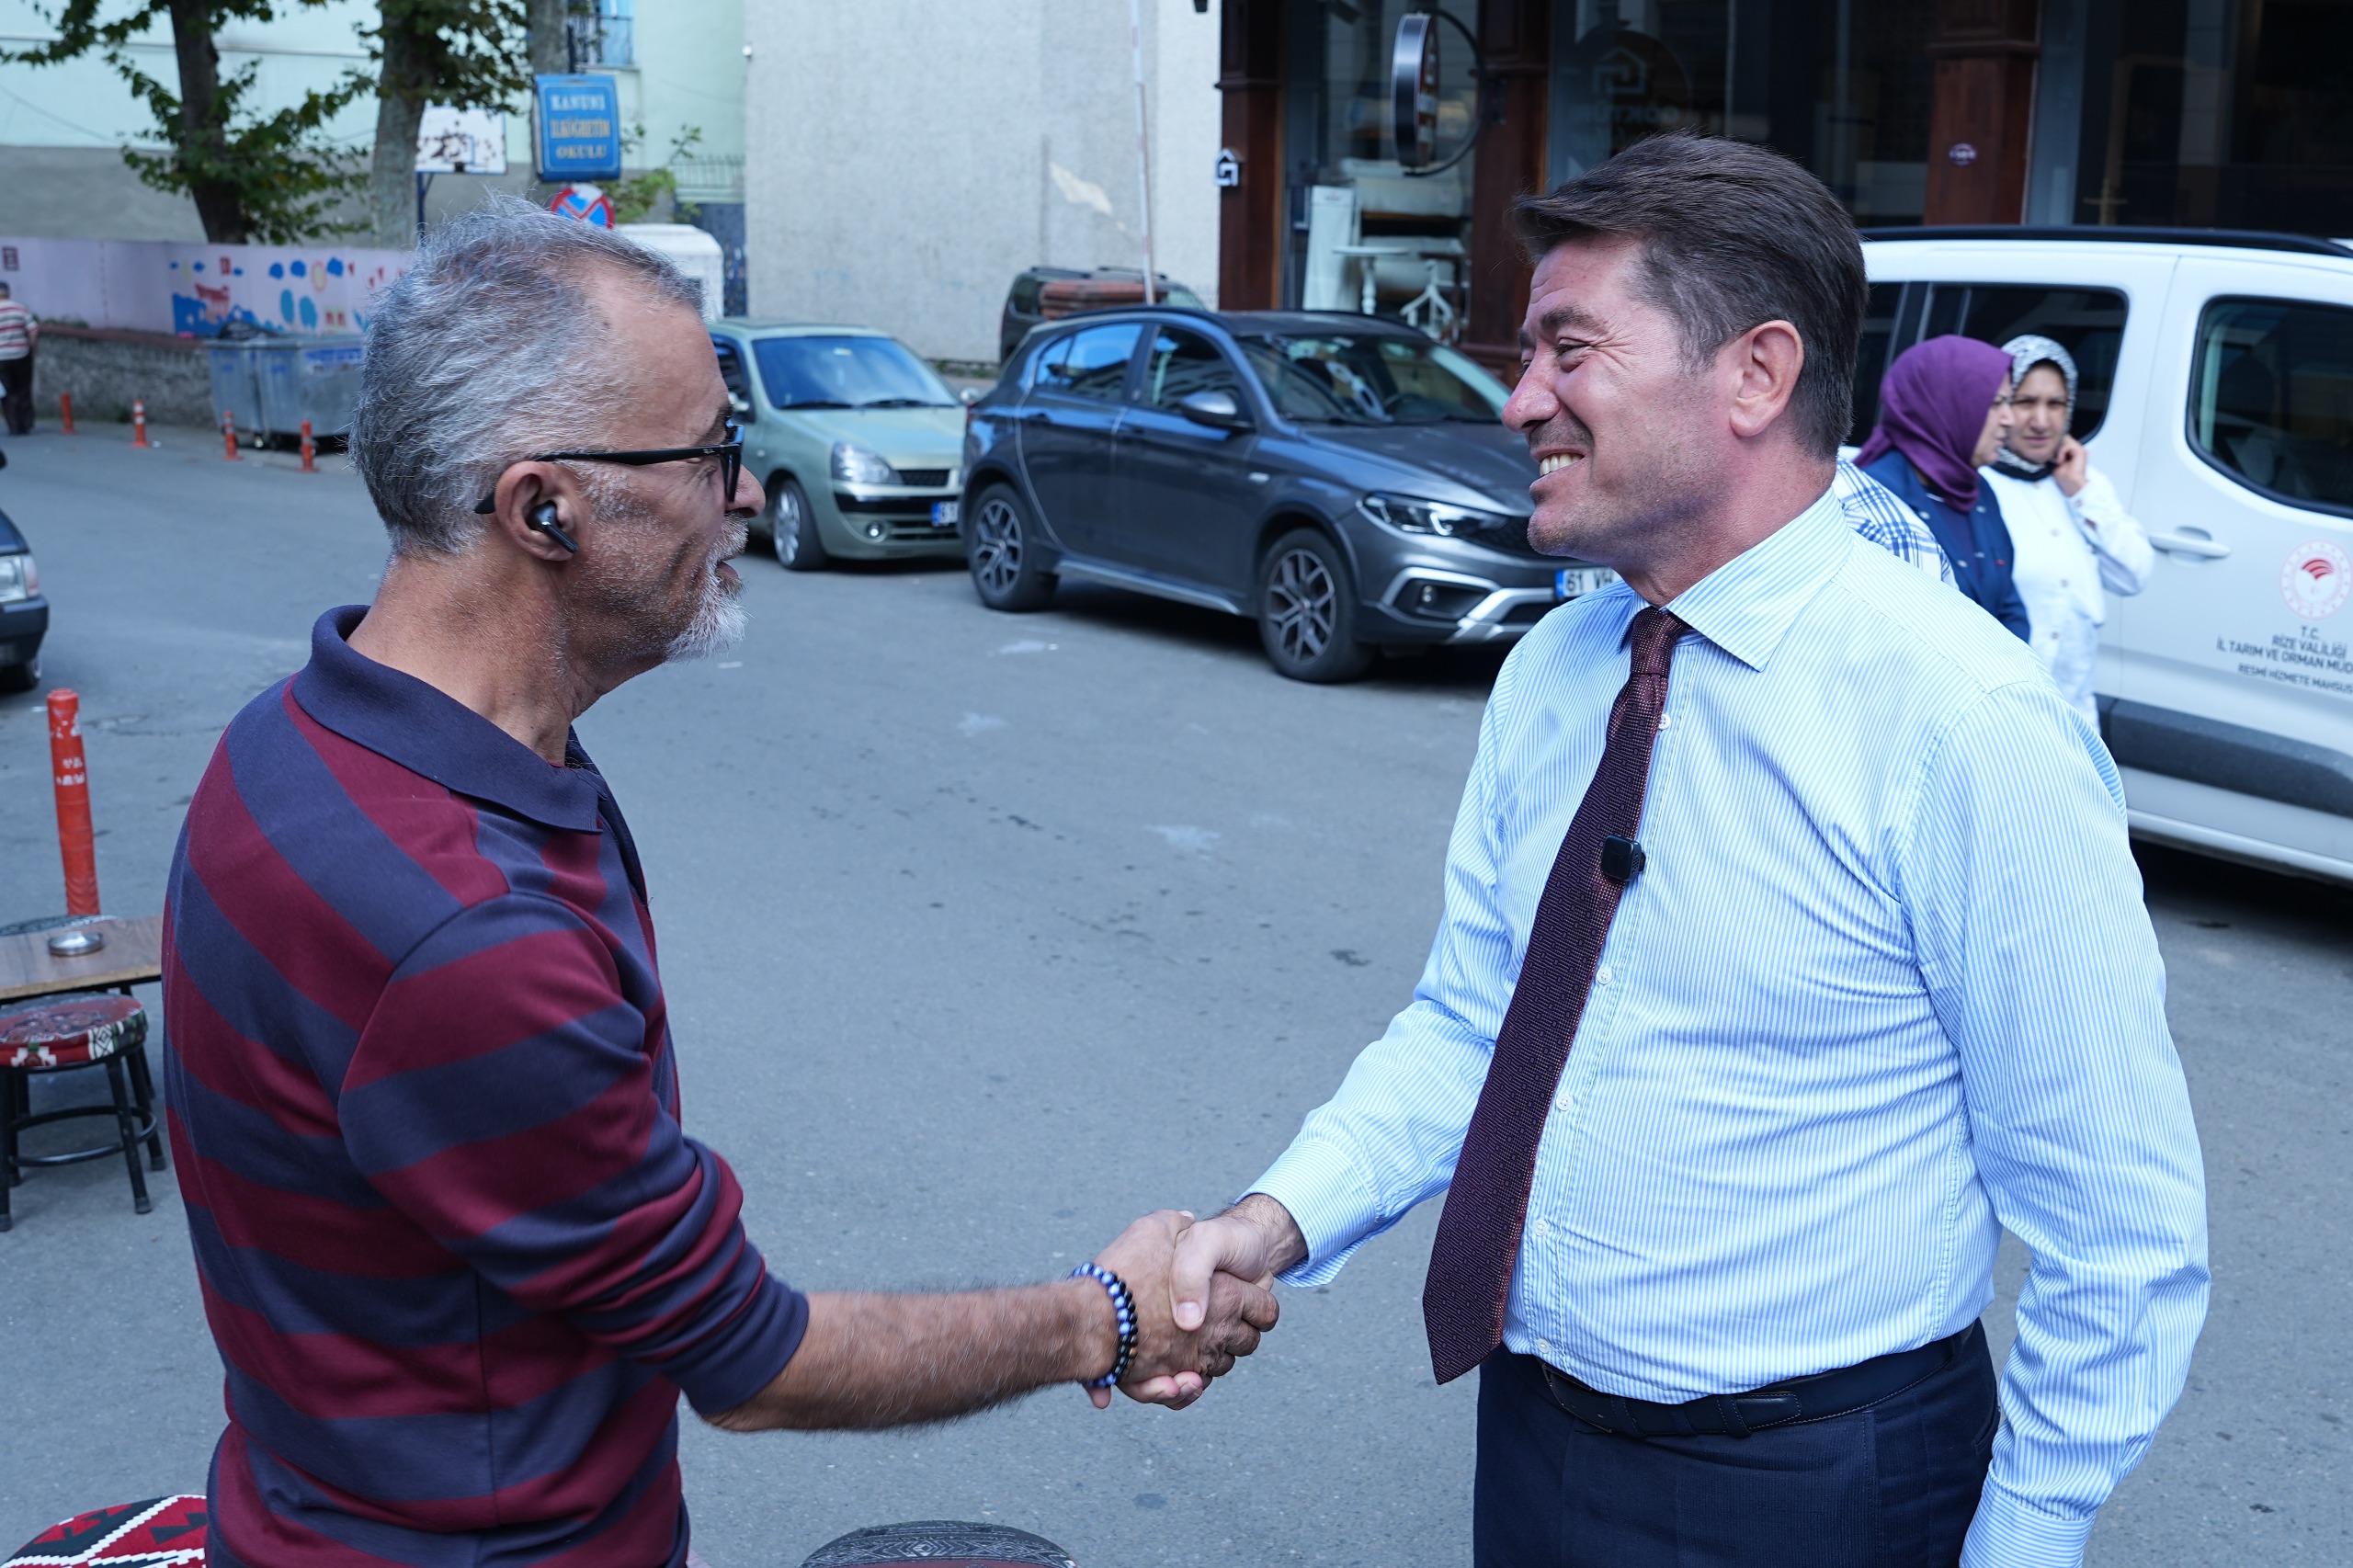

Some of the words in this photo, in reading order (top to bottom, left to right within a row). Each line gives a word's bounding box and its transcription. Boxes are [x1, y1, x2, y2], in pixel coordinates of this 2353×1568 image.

[555, 144, 608, 159] OKULU
[1566, 572, 1584, 592] 61
[2301, 625, 2321, 640] T.C.
[2215, 634, 2226, 651] İL
[2229, 640, 2264, 656] TARIM
[2266, 648, 2279, 660] VE
[2281, 651, 2324, 667] ORMAN
[2272, 634, 2296, 649] RİZE
[2299, 640, 2347, 659] VALİLİĞİ
[2237, 662, 2267, 676] RESMİ
[2268, 668, 2310, 685] HİZMETE
